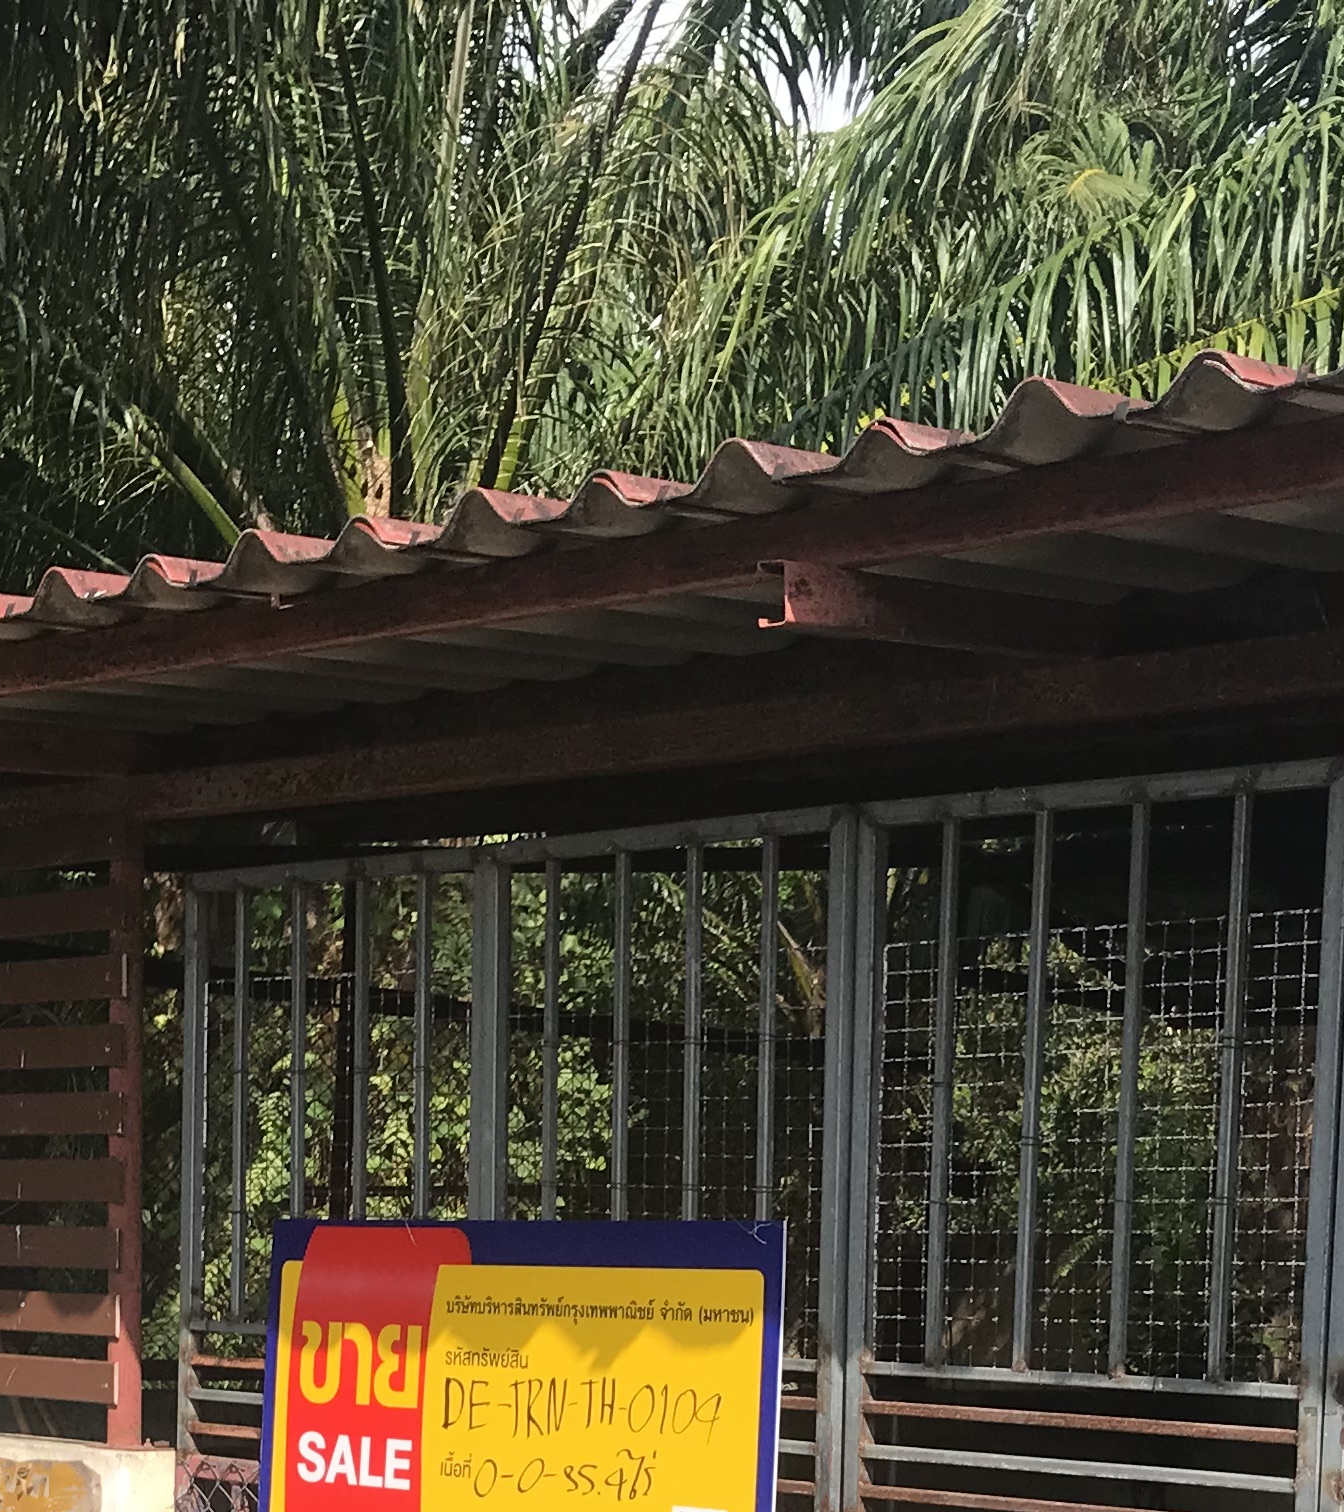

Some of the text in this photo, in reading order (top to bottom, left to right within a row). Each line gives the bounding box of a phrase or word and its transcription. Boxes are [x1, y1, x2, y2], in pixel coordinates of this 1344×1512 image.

[446, 1295, 754, 1326] บริษัทบริหารสินทรัพย์กรุงเทพพาณิชย์ จำกัด (มหาชน)
[299, 1320, 422, 1408] ขาย
[445, 1347, 529, 1370] รหัสทรัพย์สิน
[297, 1431, 413, 1490] SALE
[440, 1451, 472, 1479] เนื้อที่
